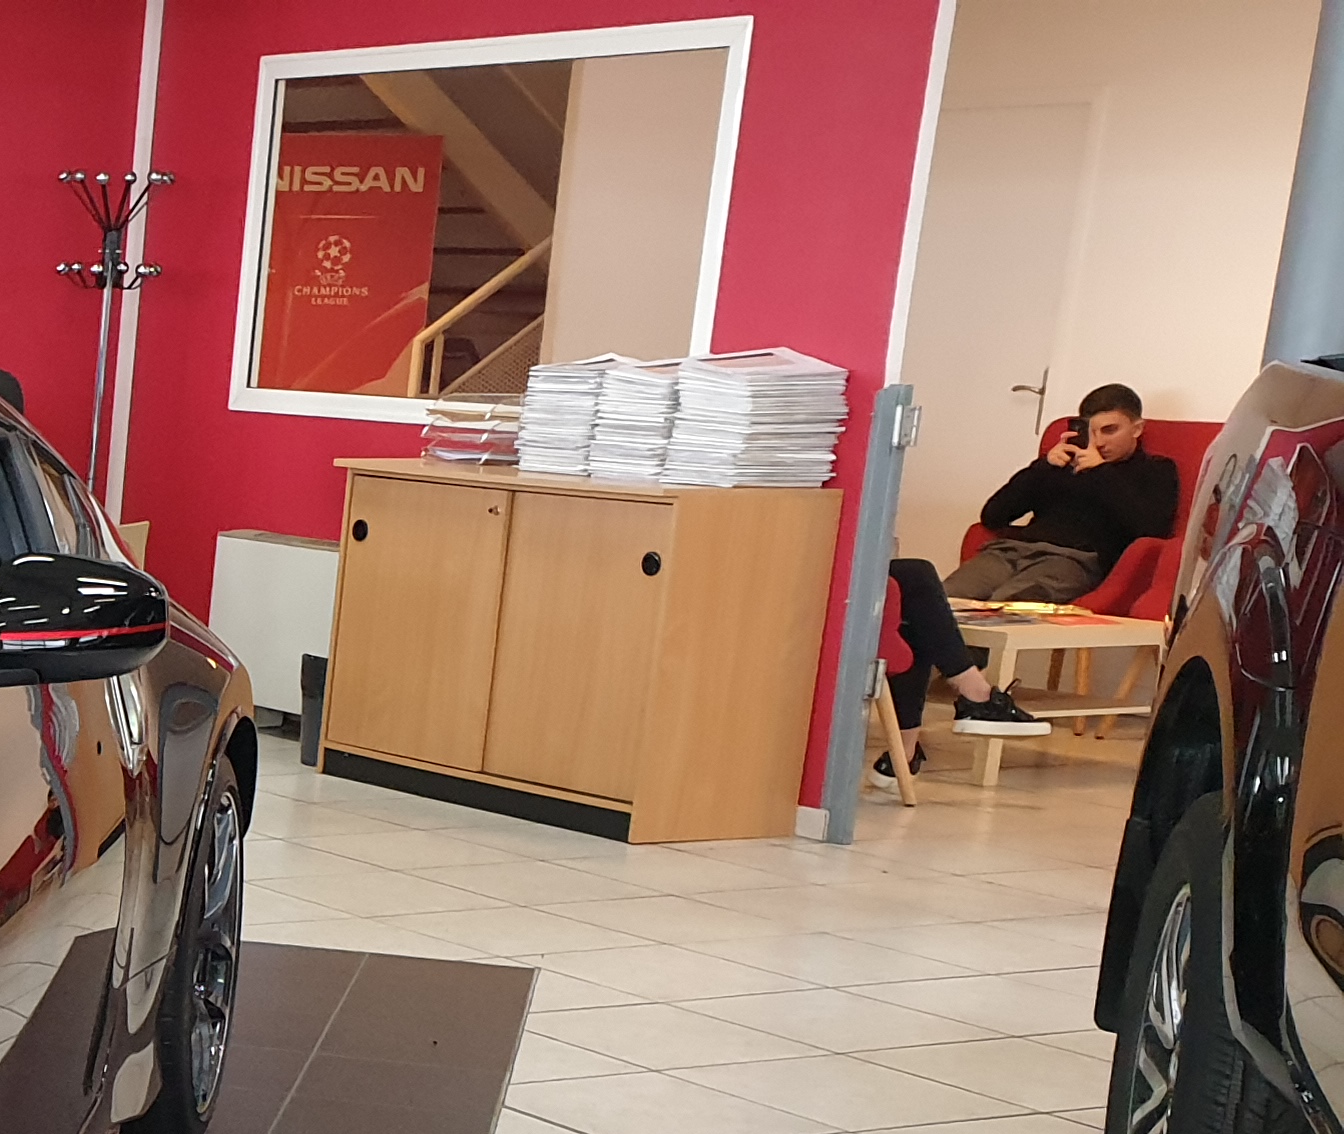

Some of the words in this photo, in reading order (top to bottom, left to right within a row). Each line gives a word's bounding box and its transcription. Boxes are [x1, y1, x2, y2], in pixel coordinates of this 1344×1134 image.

[277, 165, 426, 193] NISSAN
[294, 285, 369, 297] CHAMPIONS
[310, 297, 349, 306] LEAGUE
